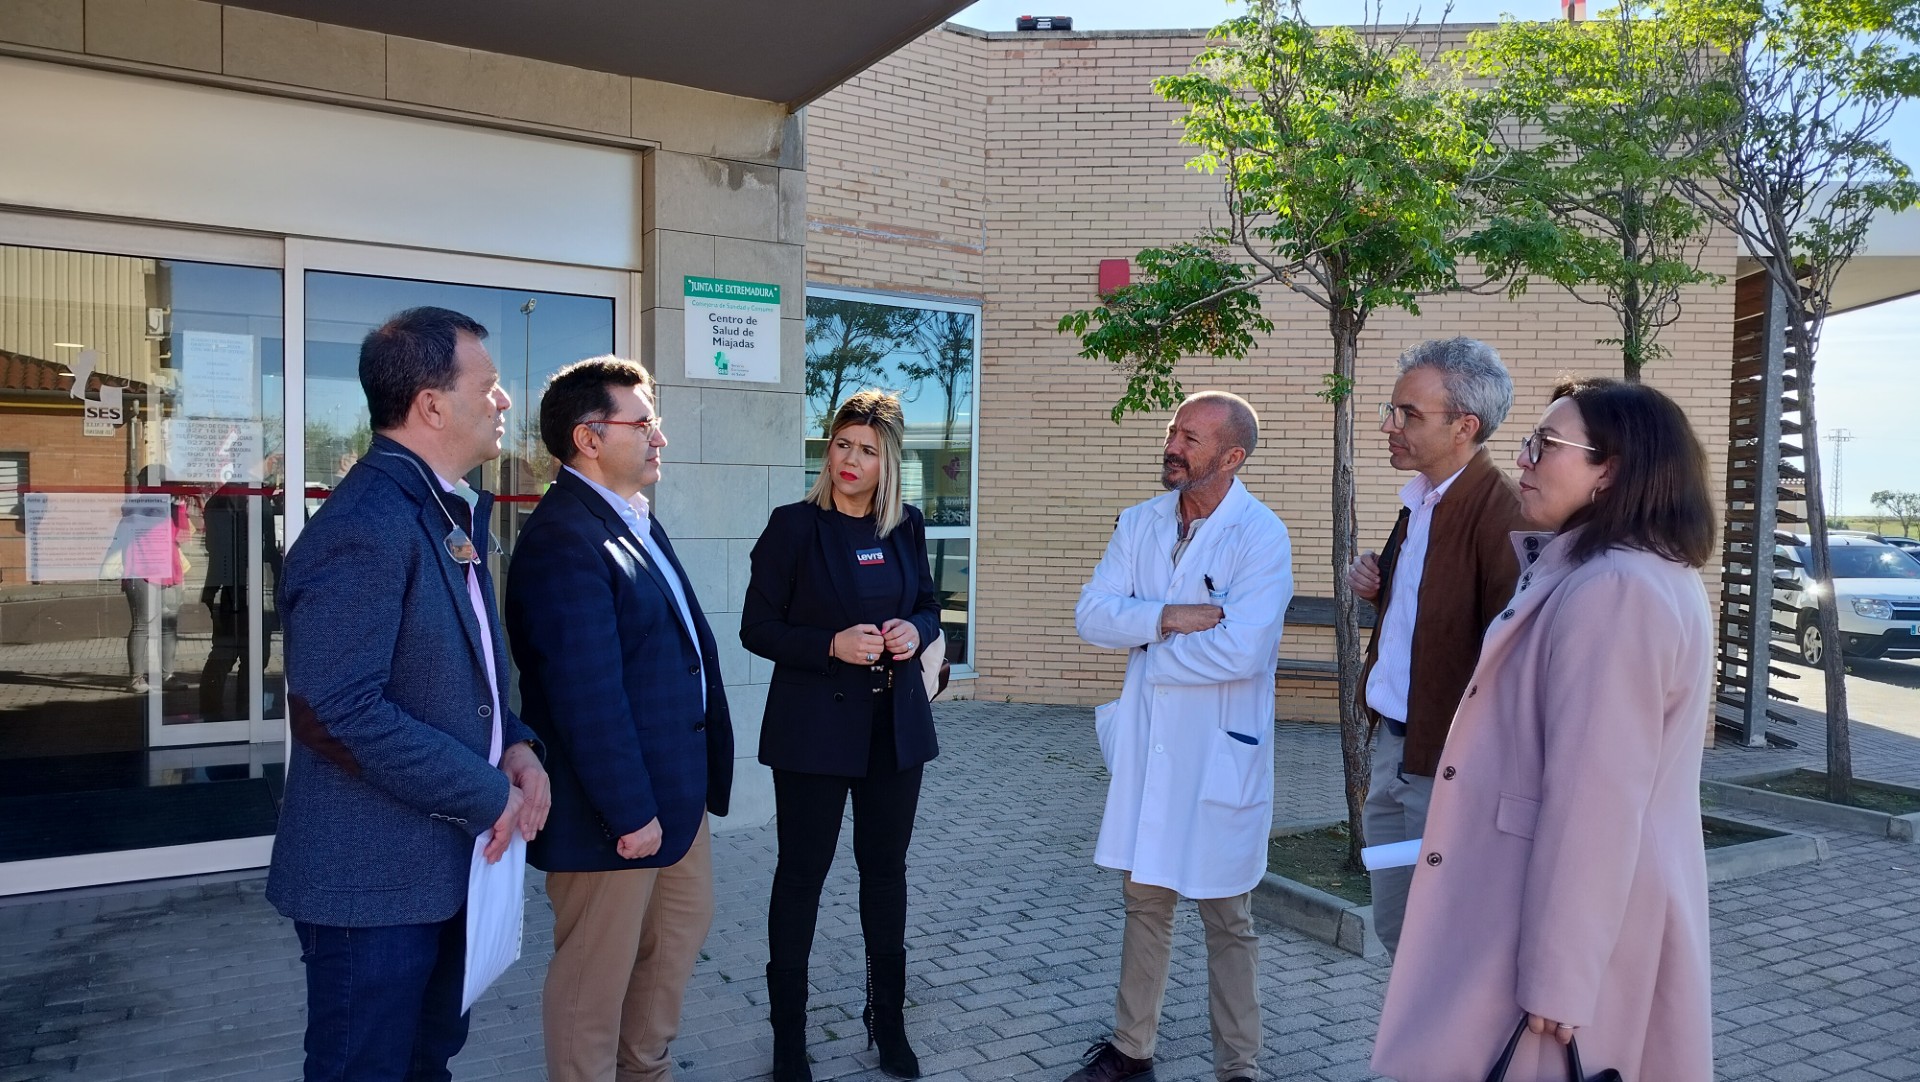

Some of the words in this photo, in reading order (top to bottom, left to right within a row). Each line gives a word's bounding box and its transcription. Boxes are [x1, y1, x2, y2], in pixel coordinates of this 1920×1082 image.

[691, 281, 714, 292] JUNTA
[715, 283, 724, 293] DE
[725, 284, 774, 298] EXTREMADURA
[726, 302, 745, 310] Sanidad
[708, 312, 743, 325] Centro
[745, 315, 758, 326] de
[712, 325, 740, 337] Salud
[742, 327, 755, 337] de
[712, 337, 755, 349] Miajadas
[86, 407, 121, 420] SES
